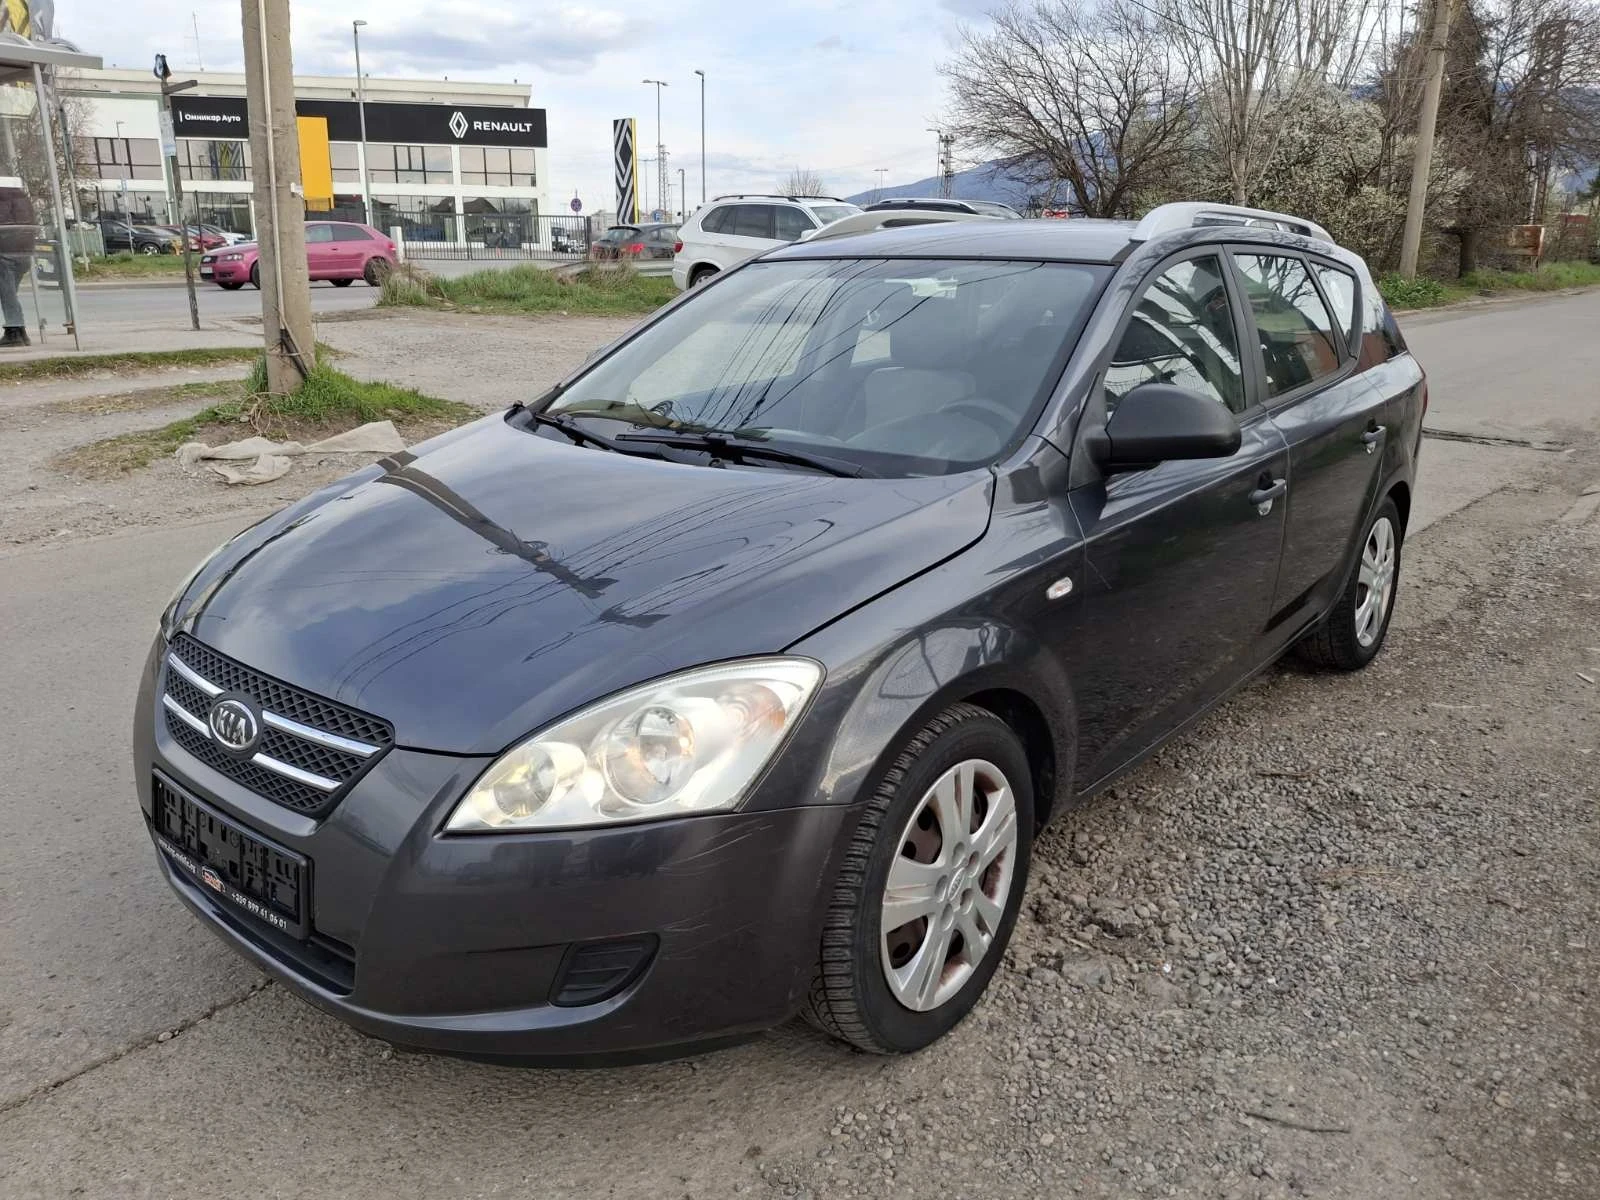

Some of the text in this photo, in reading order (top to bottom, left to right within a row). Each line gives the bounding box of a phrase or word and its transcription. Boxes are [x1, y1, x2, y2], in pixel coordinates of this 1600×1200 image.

[184, 113, 241, 123] Омникар Ауто
[473, 121, 533, 133] RENAULT
[216, 706, 246, 745] KIA
[269, 913, 278, 925] 06
[279, 919, 287, 929] 01
